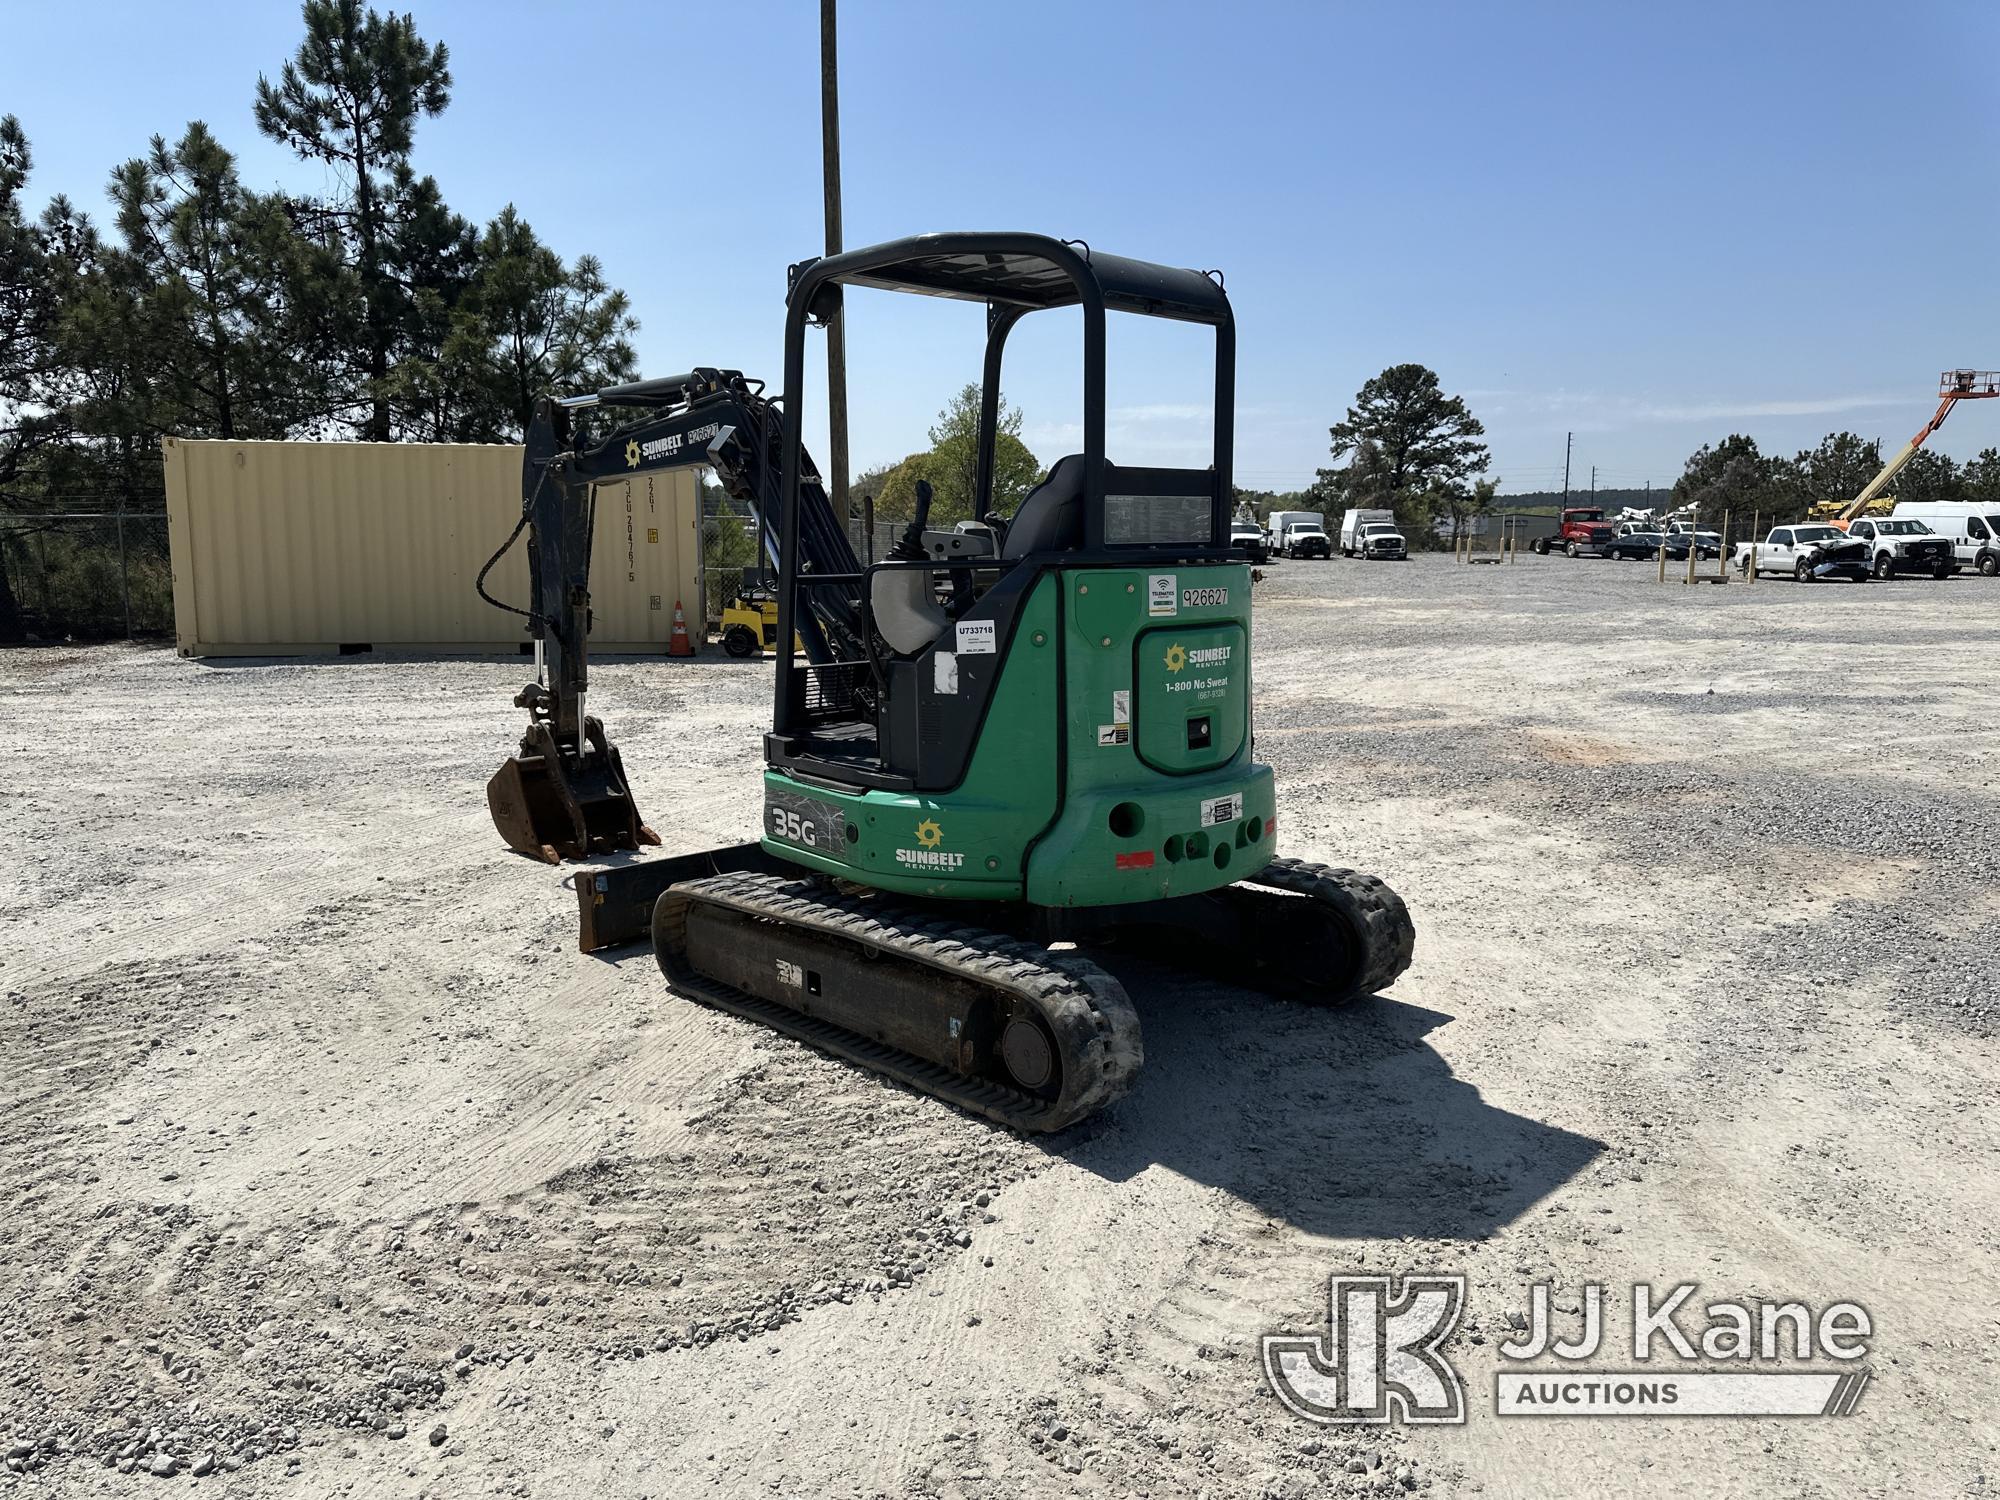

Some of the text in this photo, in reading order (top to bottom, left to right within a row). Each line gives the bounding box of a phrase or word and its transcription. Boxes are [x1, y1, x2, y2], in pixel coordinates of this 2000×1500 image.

[688, 424, 718, 443] 926627
[642, 434, 682, 457] SUNBELT
[648, 449, 678, 461] RENTALS
[628, 571, 635, 582] 5
[1183, 589, 1228, 606] 926627
[959, 626, 993, 635] U733718
[1189, 646, 1231, 664] SUNBELT
[1195, 660, 1226, 668] RENTALS
[1165, 677, 1228, 692] 1-800 No Sweat
[772, 808, 816, 847] 35G
[895, 848, 966, 868] SUNBELT
[904, 862, 955, 872] RENTALS
